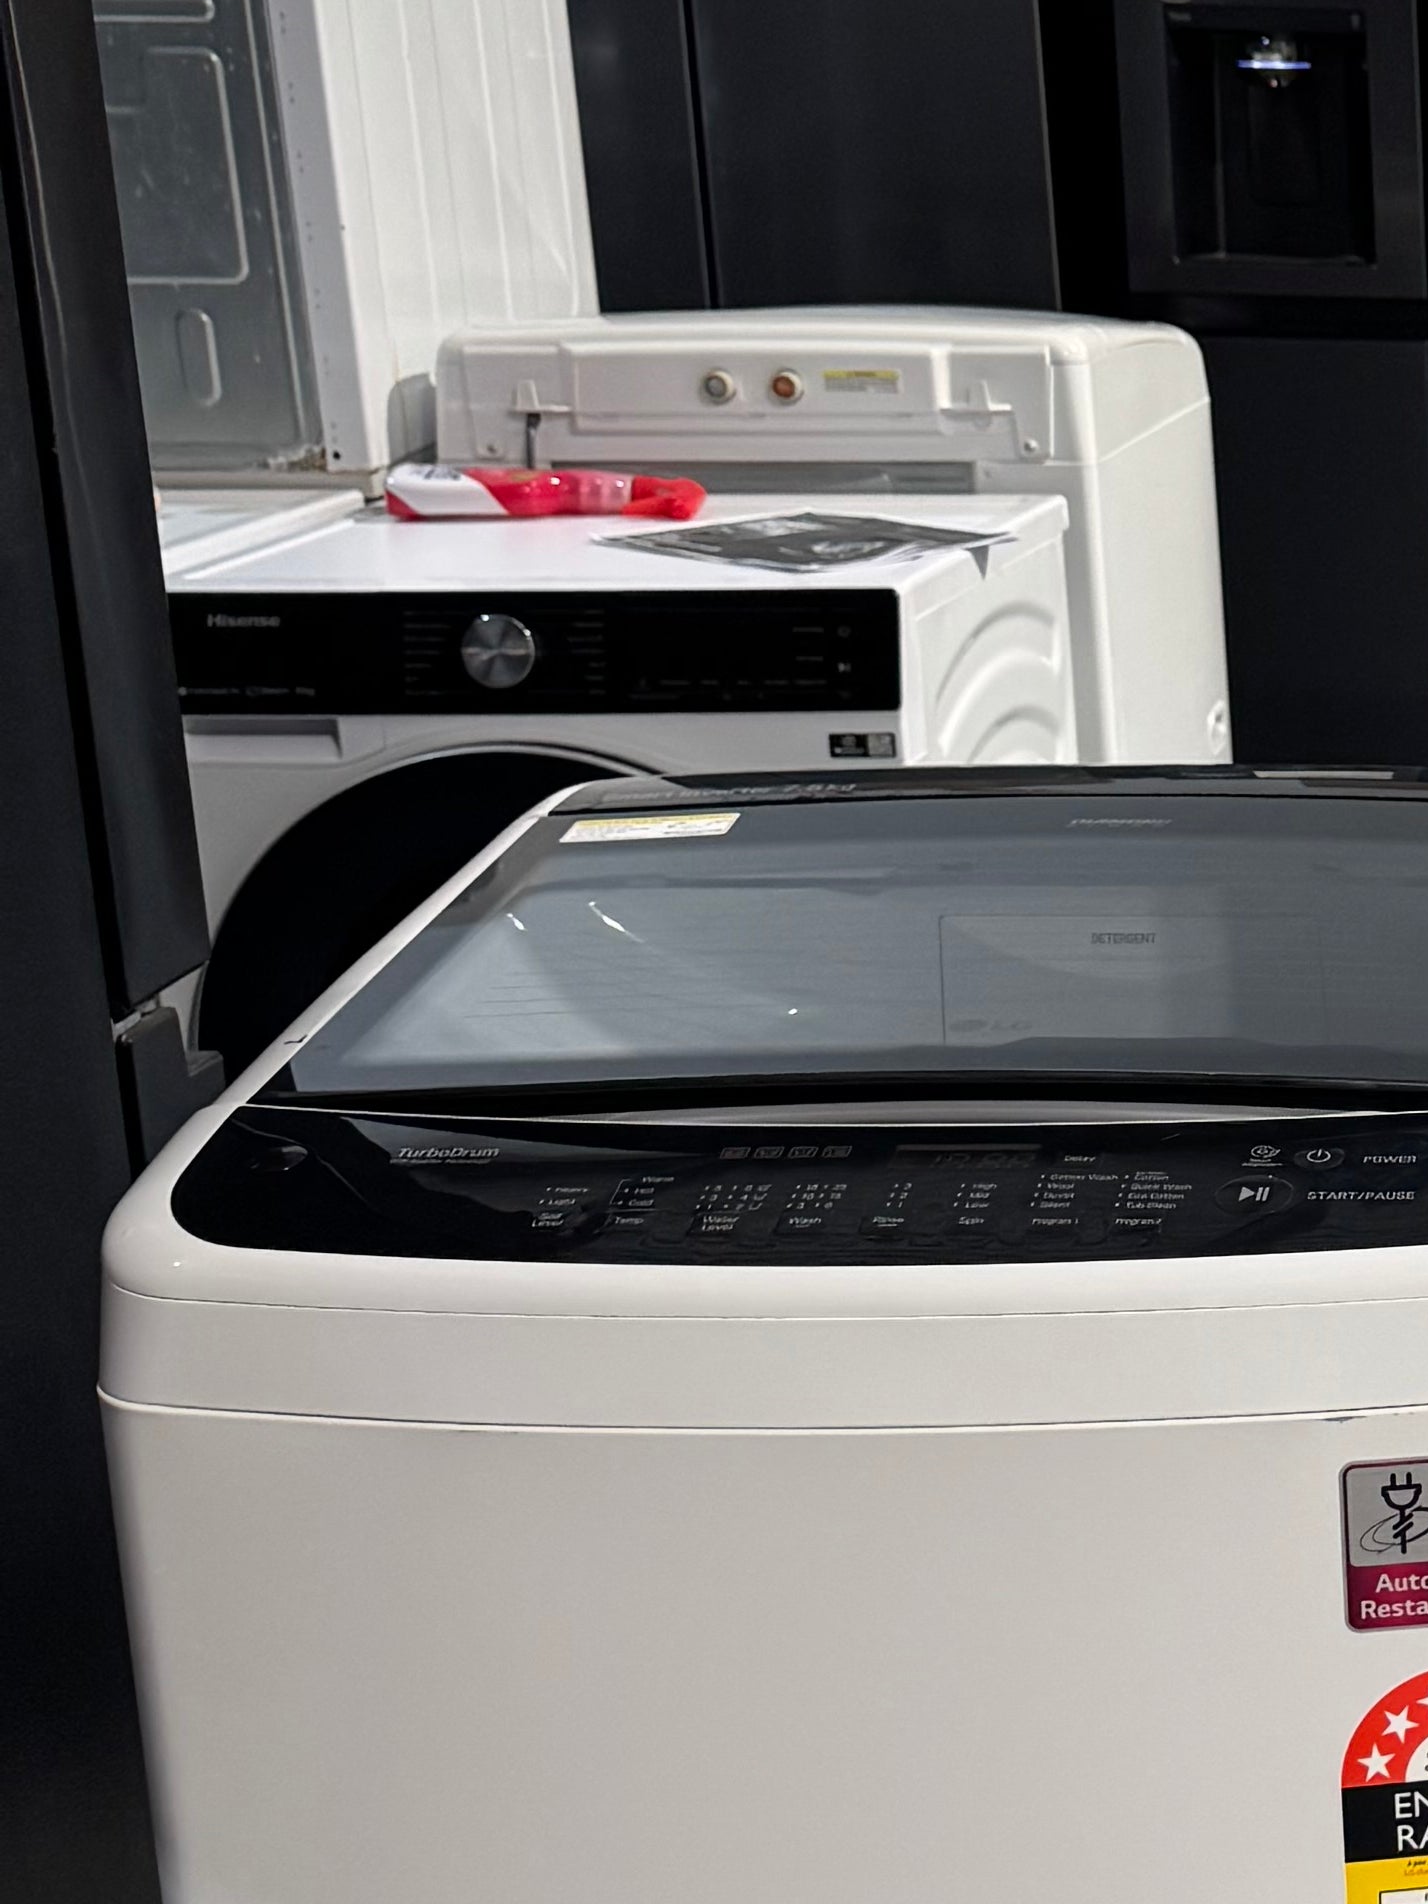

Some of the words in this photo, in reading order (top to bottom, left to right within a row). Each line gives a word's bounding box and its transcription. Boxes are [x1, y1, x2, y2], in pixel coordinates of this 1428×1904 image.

[207, 613, 281, 628] Hisense
[1090, 932, 1157, 945] DETERGENT
[398, 1147, 500, 1158] TurboDrum
[1362, 1155, 1417, 1163] POWER
[1307, 1191, 1415, 1200] START/PAUSE
